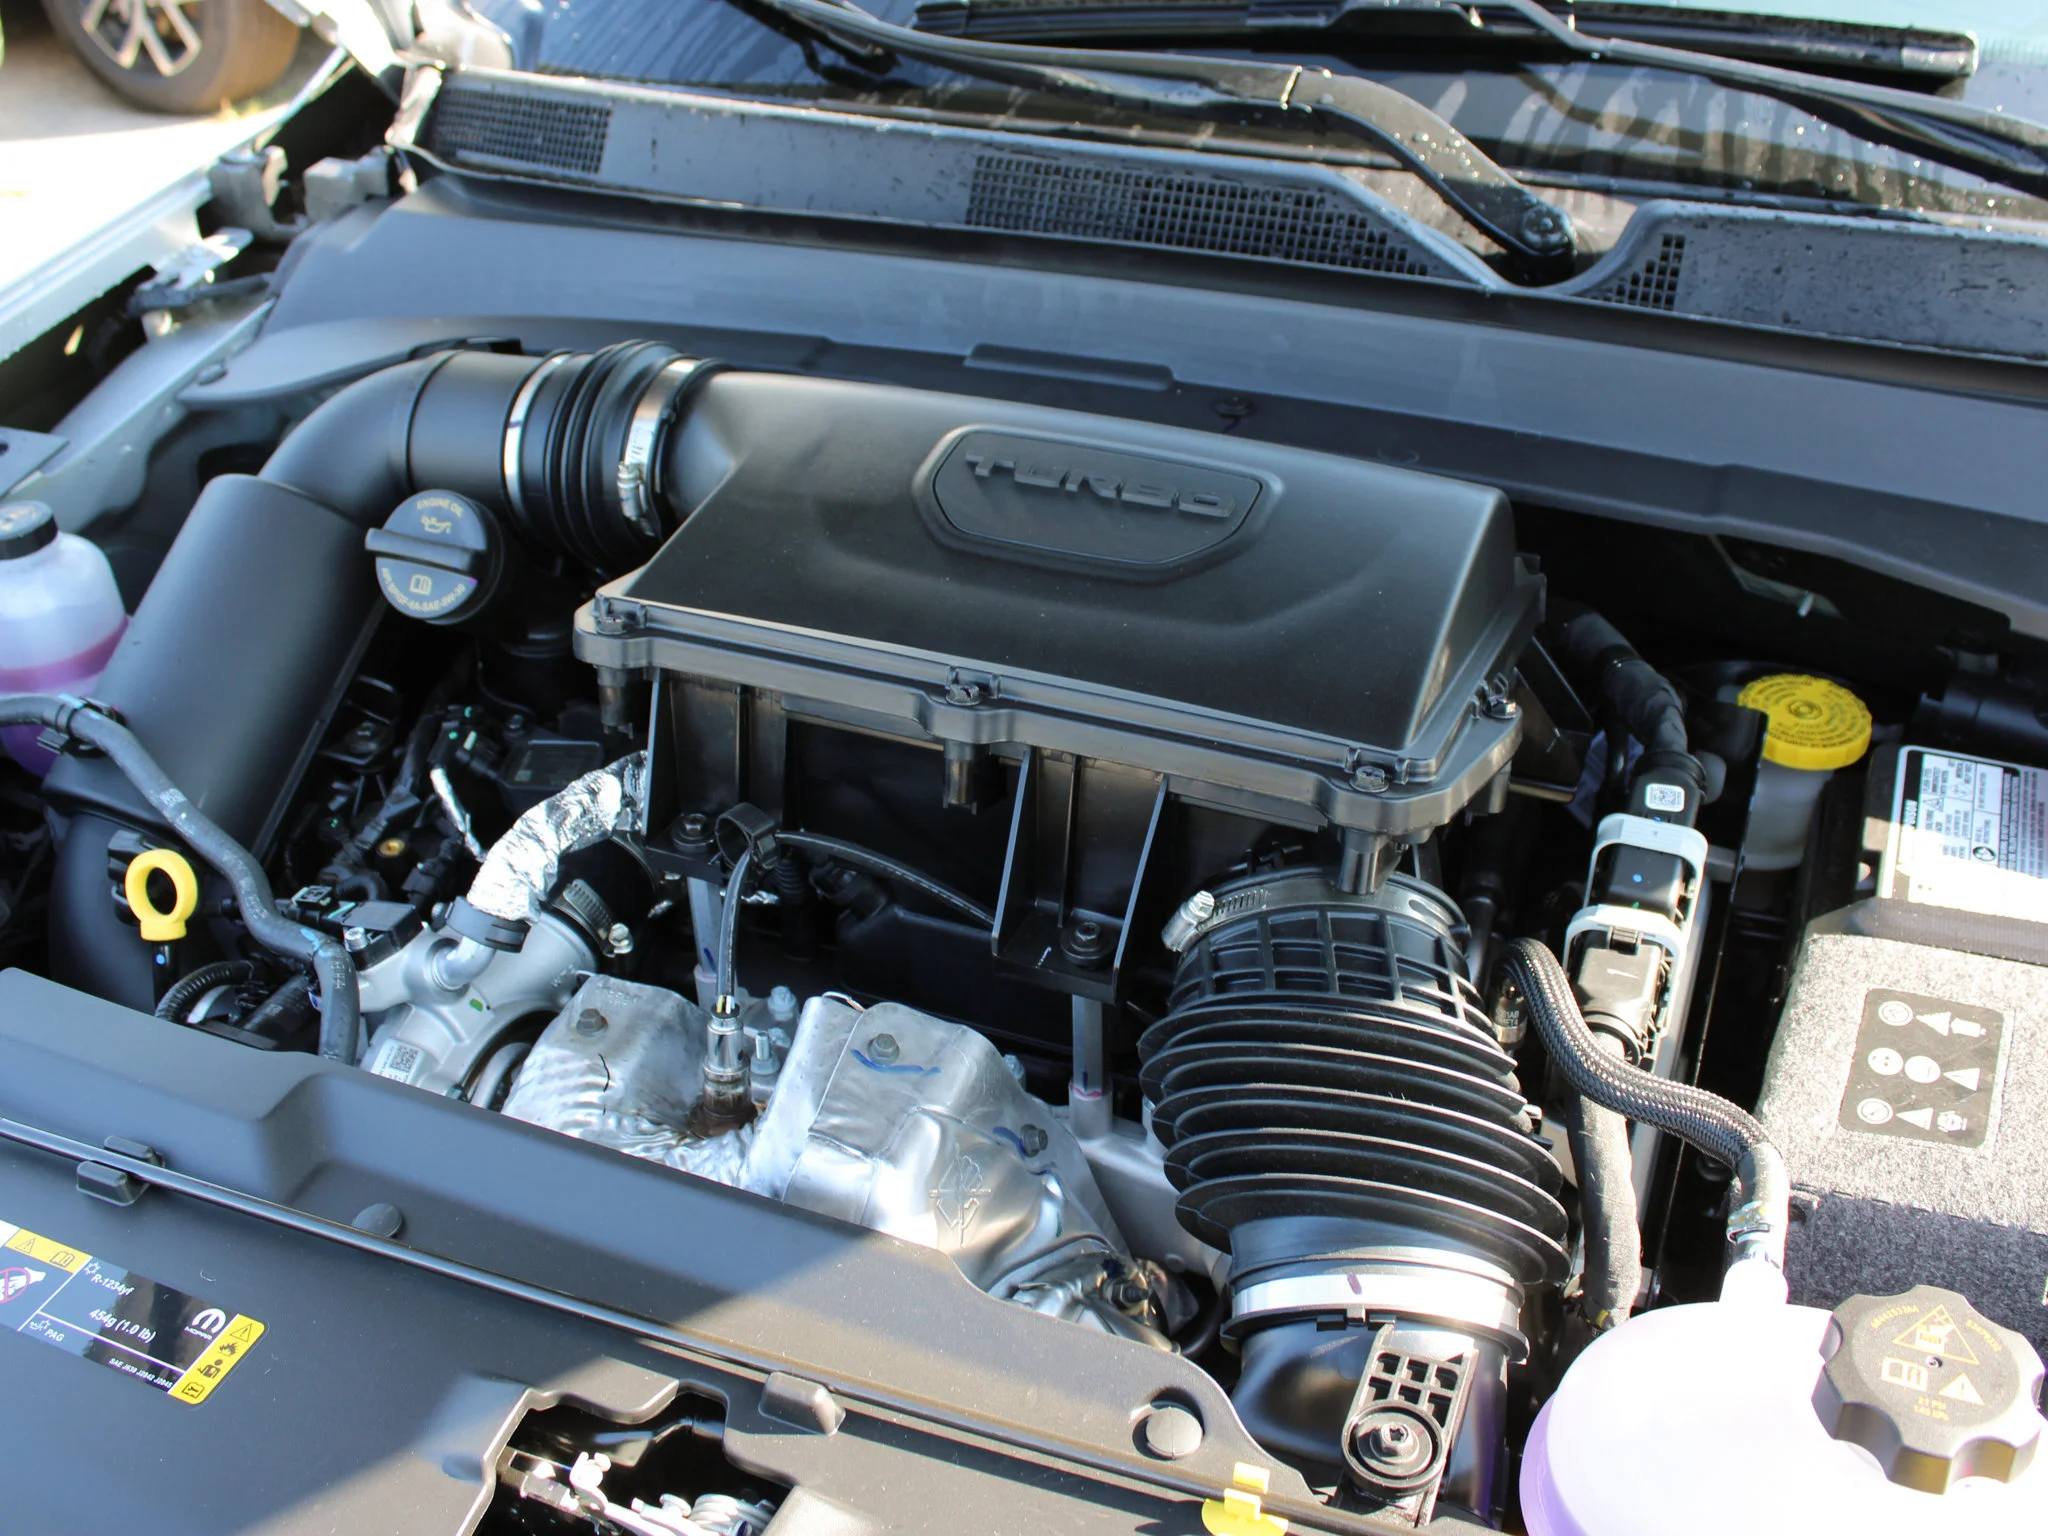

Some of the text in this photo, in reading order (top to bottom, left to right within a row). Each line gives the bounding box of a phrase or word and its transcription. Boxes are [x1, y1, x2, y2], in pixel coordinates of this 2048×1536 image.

[966, 452, 1236, 518] TURBO
[91, 1273, 135, 1296] R-1234yf
[44, 1328, 65, 1342] PAG
[89, 1308, 156, 1343] 454g (1.0 lb)
[109, 1357, 124, 1368] SAE
